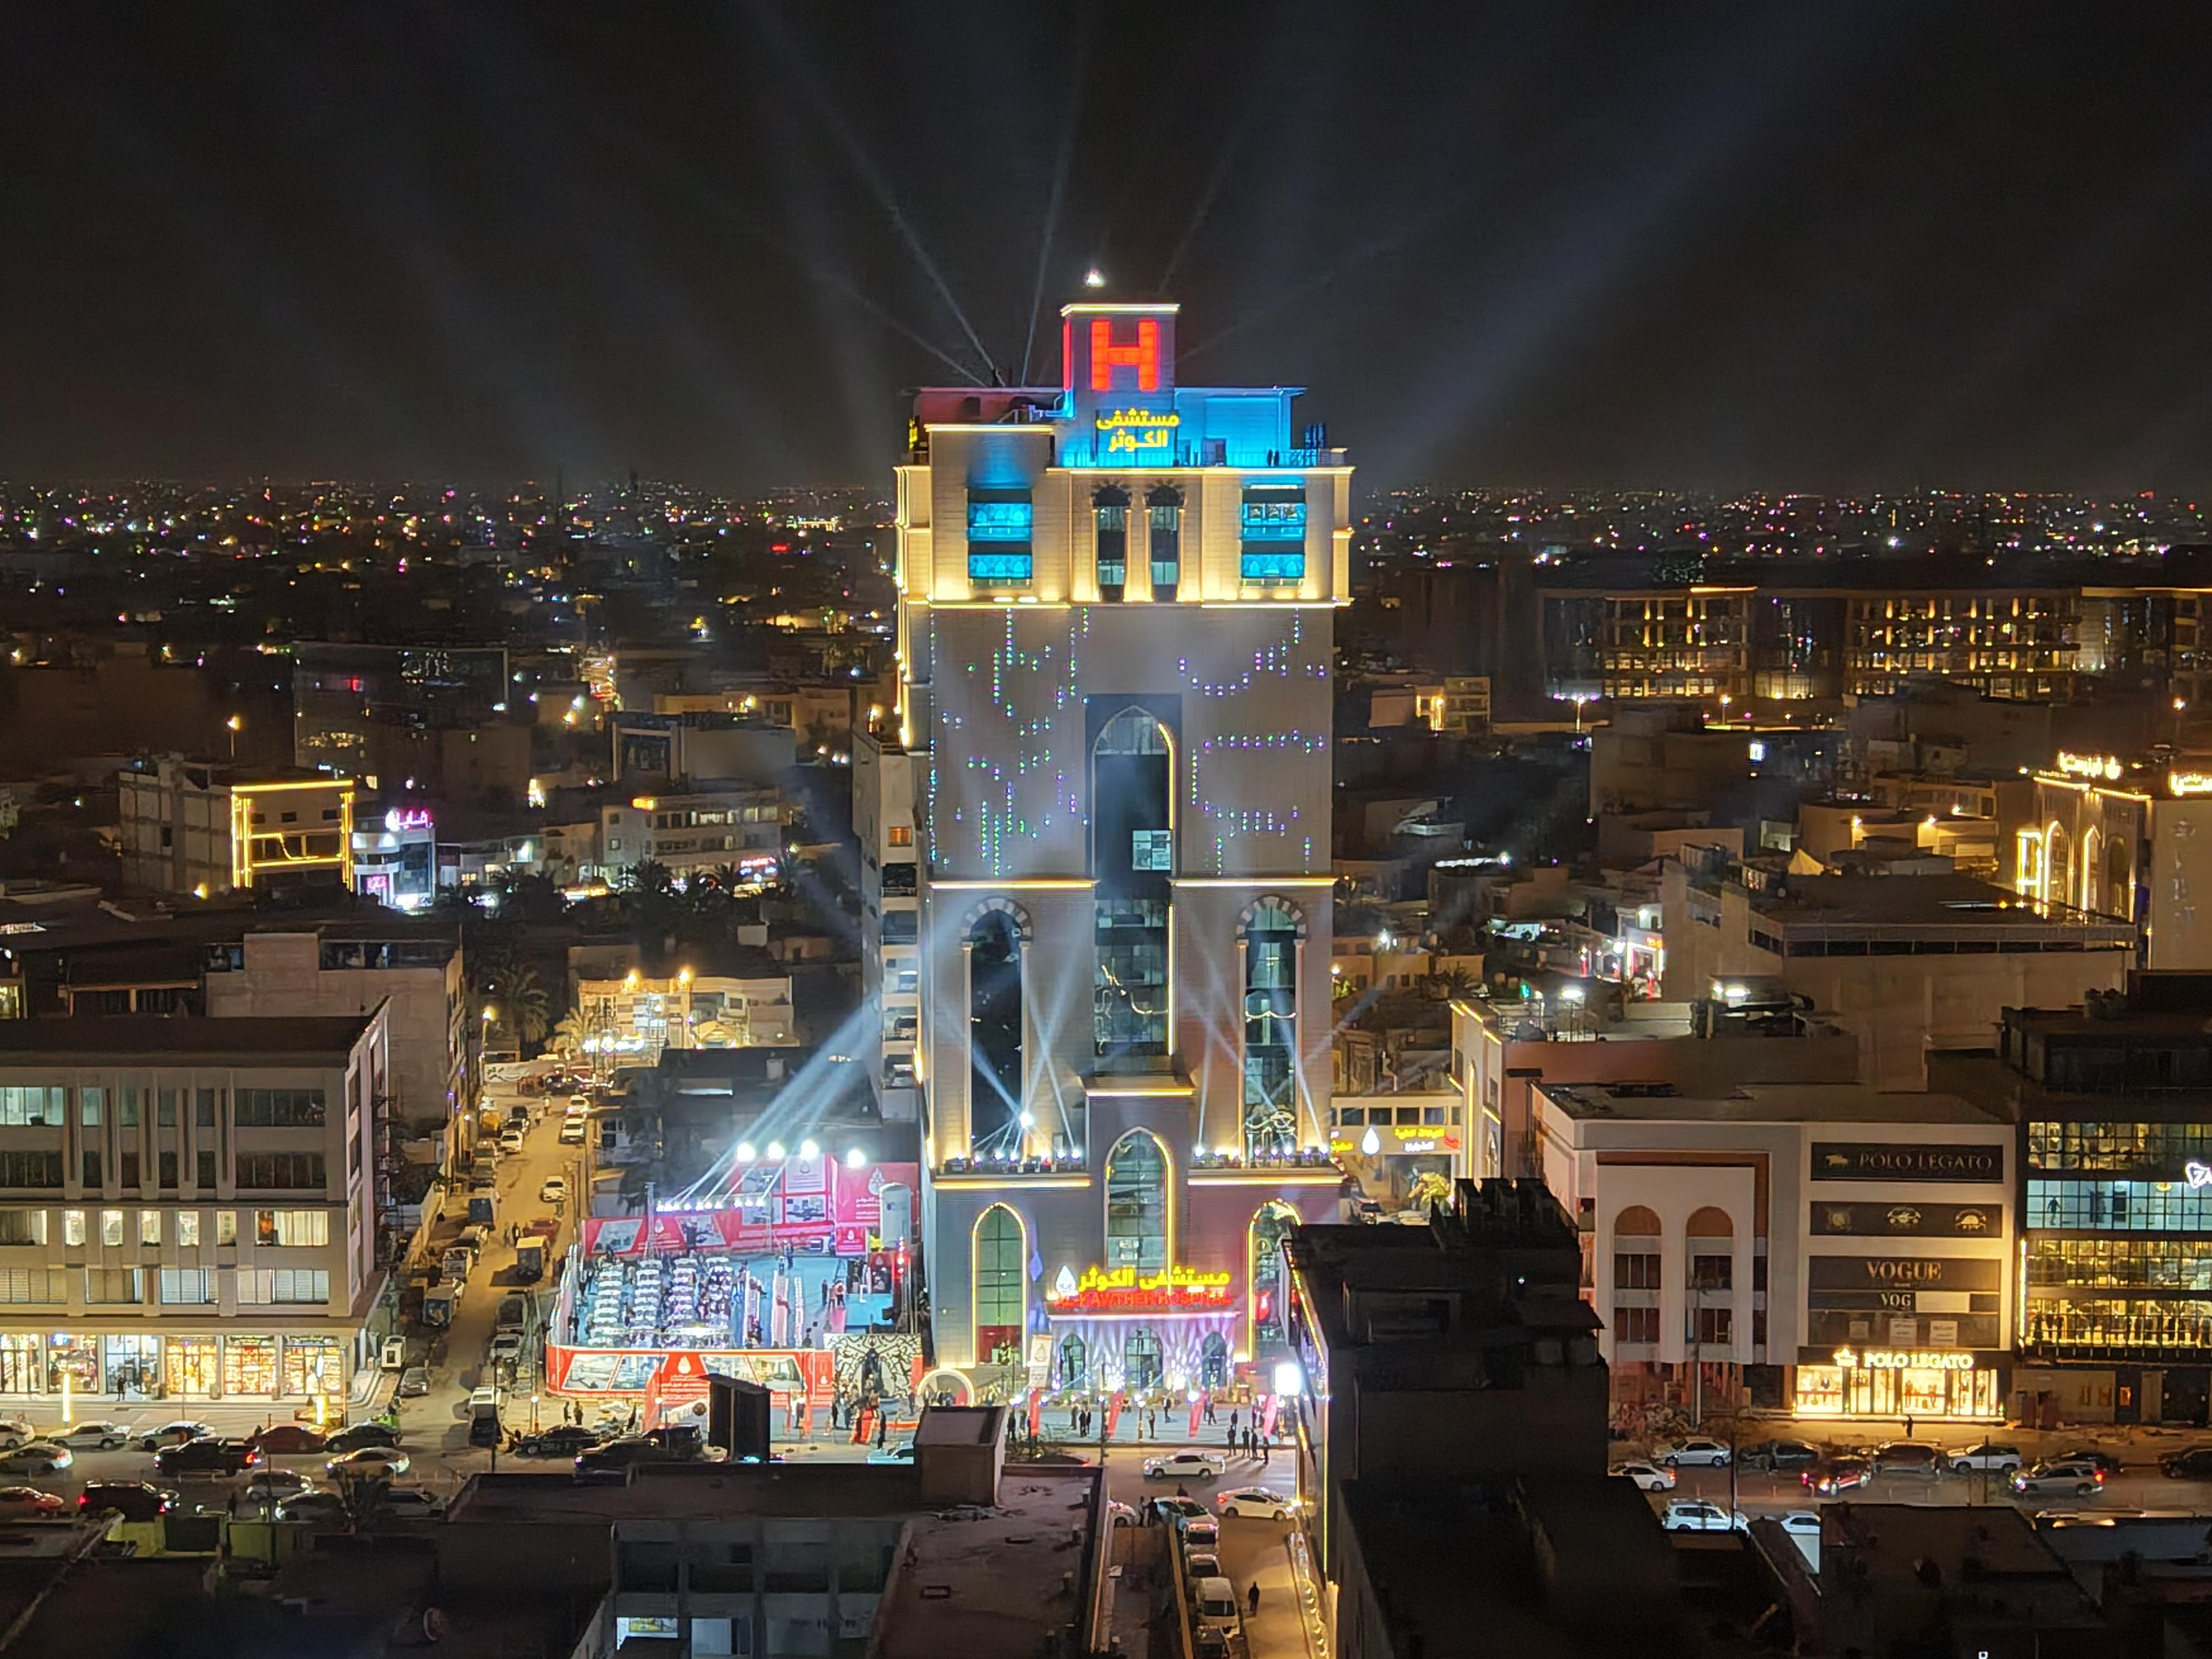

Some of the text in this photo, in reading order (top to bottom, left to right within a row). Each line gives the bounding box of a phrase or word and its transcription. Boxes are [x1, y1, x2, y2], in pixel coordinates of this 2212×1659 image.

[1091, 320, 1158, 392] H
[1096, 408, 1180, 430] مستشفى
[1108, 428, 1168, 452] الكوثر
[1859, 1152, 1993, 1170] POLO LEGATO
[1078, 1264, 1230, 1292] مستشفى الكوثر
[1866, 1261, 1942, 1280] VOGUE
[1863, 1352, 1974, 1369] POLO LEGATO
